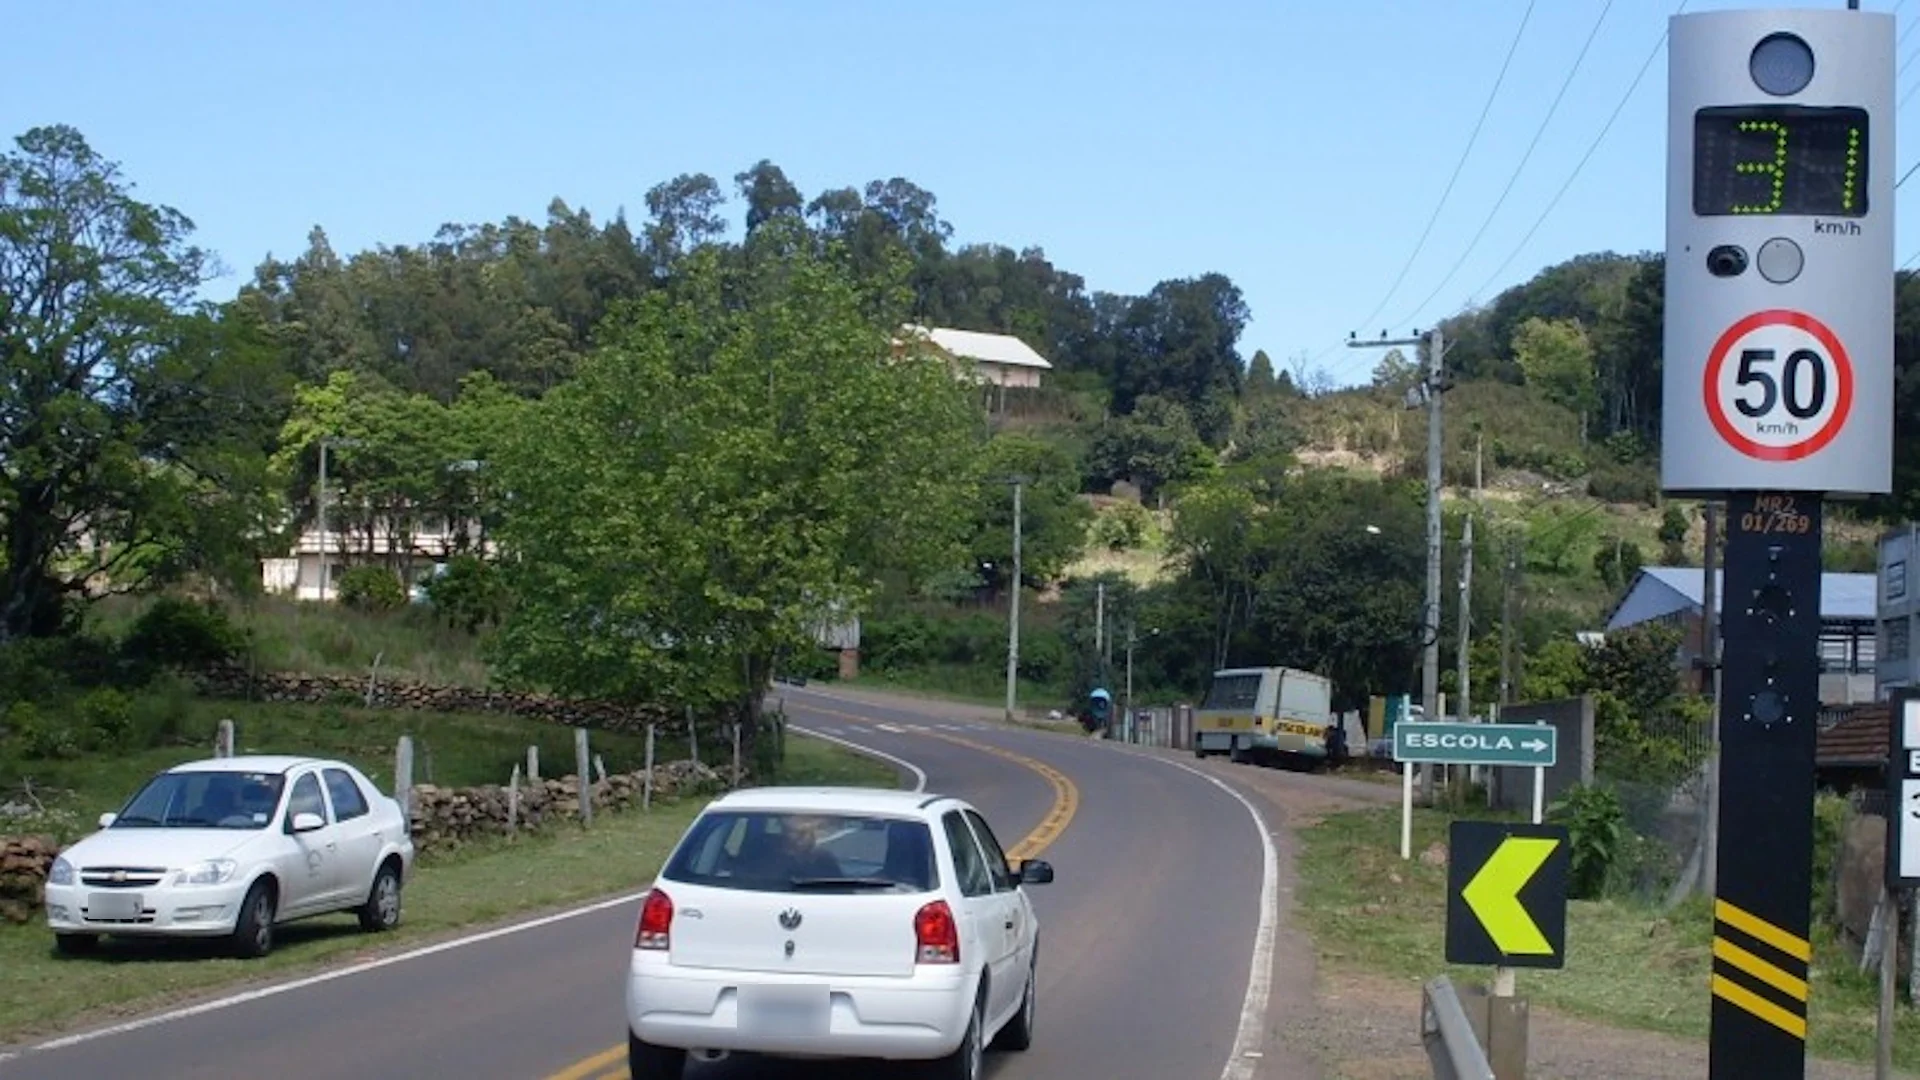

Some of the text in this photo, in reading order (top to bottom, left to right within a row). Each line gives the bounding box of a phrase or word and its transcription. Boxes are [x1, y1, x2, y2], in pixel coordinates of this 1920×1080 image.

[1814, 219, 1861, 236] km/h
[1735, 349, 1826, 419] 50
[1756, 422, 1799, 435] km/h
[1405, 733, 1513, 750] ESCOLA
